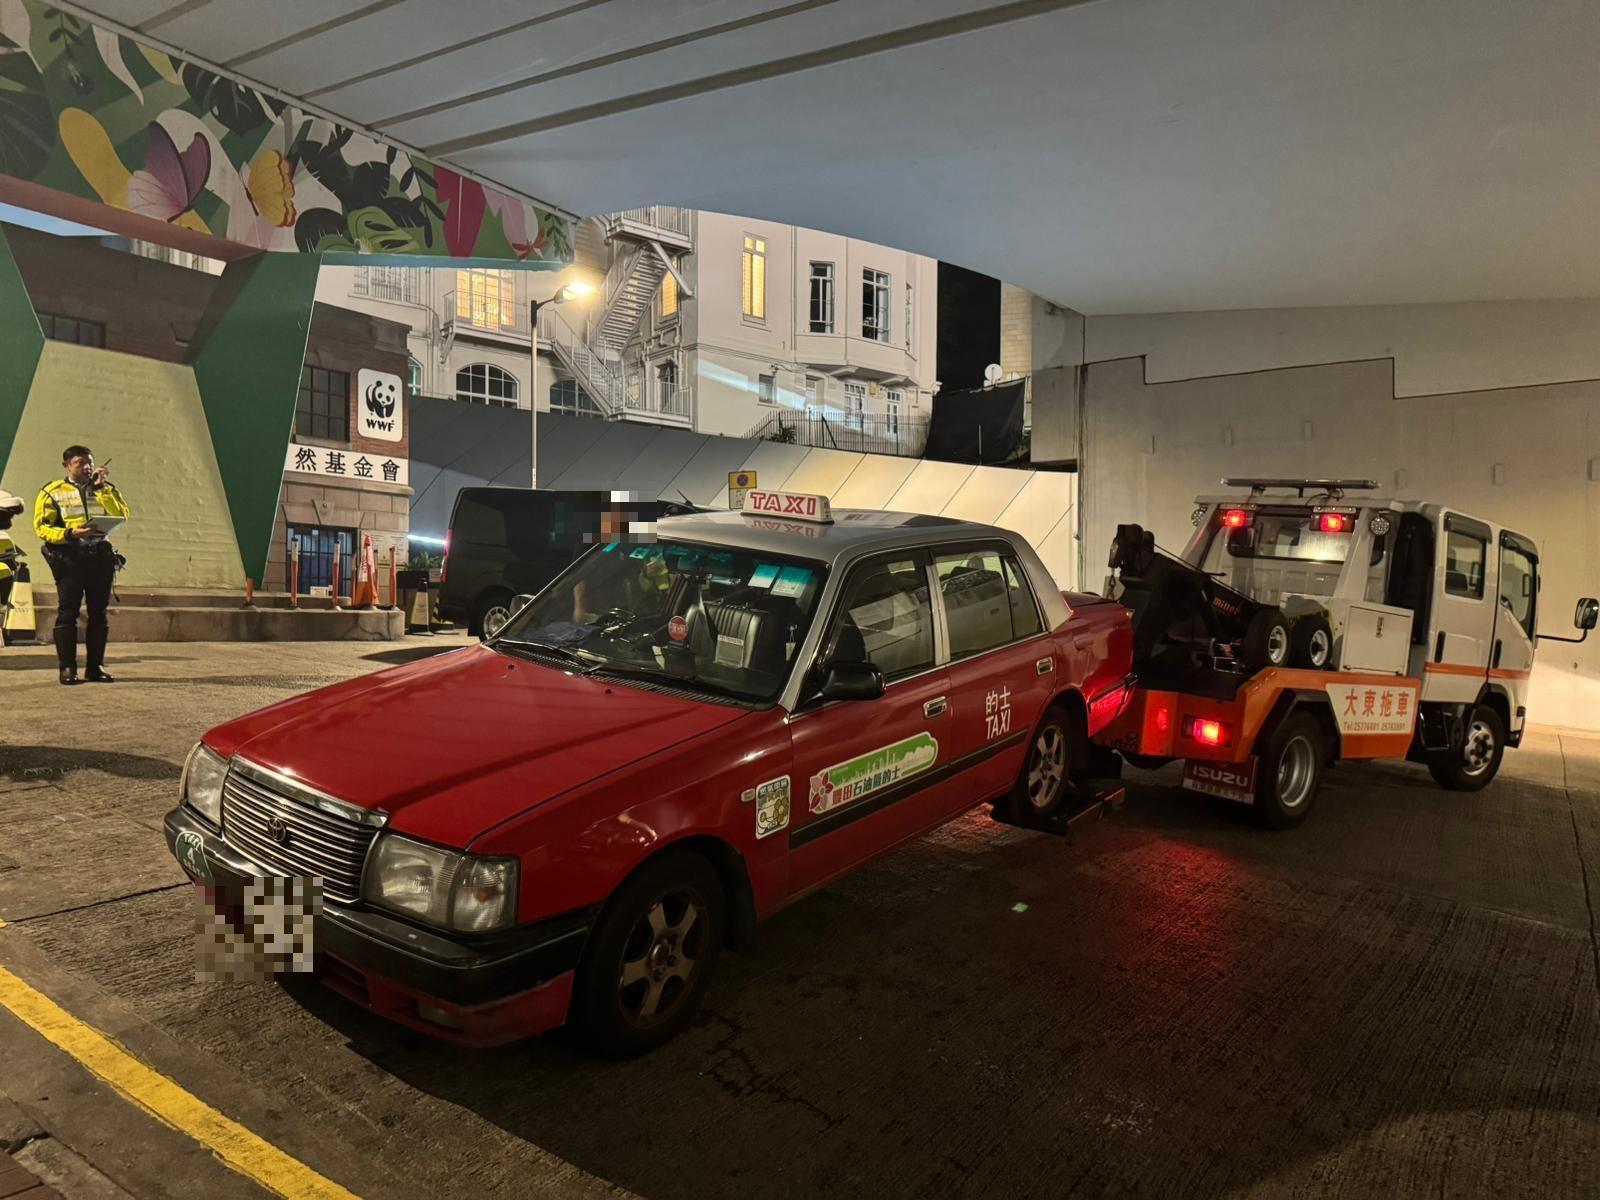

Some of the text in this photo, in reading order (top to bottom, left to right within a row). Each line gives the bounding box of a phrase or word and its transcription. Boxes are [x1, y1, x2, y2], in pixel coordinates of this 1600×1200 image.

[366, 418, 395, 432] WWF
[295, 447, 400, 482] 然基金會
[750, 491, 817, 516] TAXI
[985, 685, 1011, 715] 的士
[1343, 688, 1409, 717] 大東拖車
[985, 709, 1011, 740] TAXI
[1193, 764, 1249, 787] ISUZU
